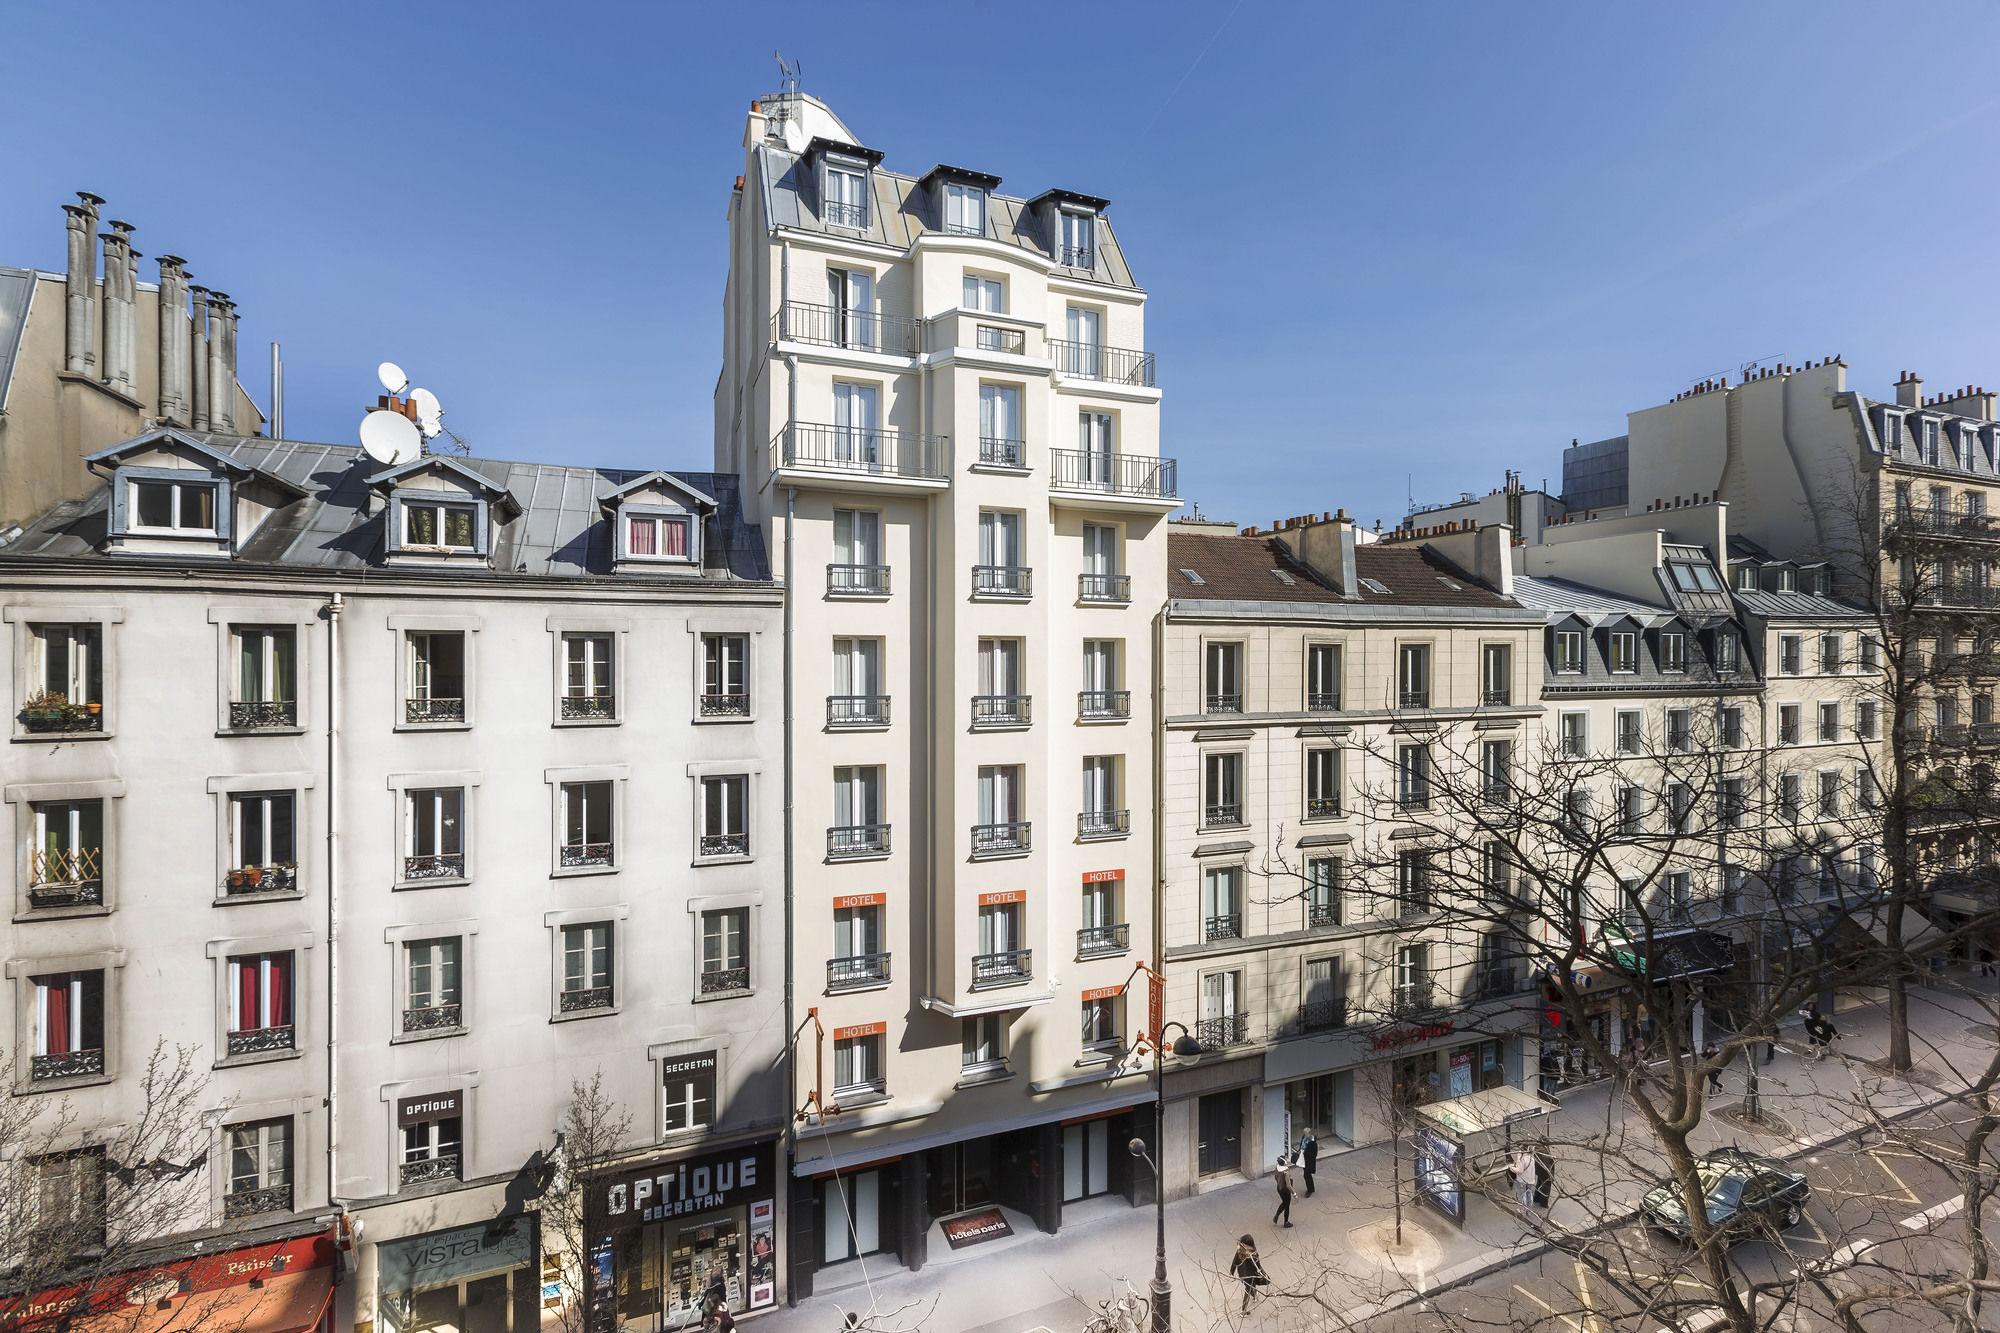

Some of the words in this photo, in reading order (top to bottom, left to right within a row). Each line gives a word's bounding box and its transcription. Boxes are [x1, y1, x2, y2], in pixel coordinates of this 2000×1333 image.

[1089, 871, 1118, 881] HOTEL
[842, 895, 877, 907] HOTEL
[986, 892, 1019, 904] HOTEL
[1089, 987, 1118, 999] HOTEL
[843, 1024, 878, 1039] HOTEL
[666, 1058, 714, 1074] SECRETAN
[643, 1192, 725, 1222] SECRETAN
